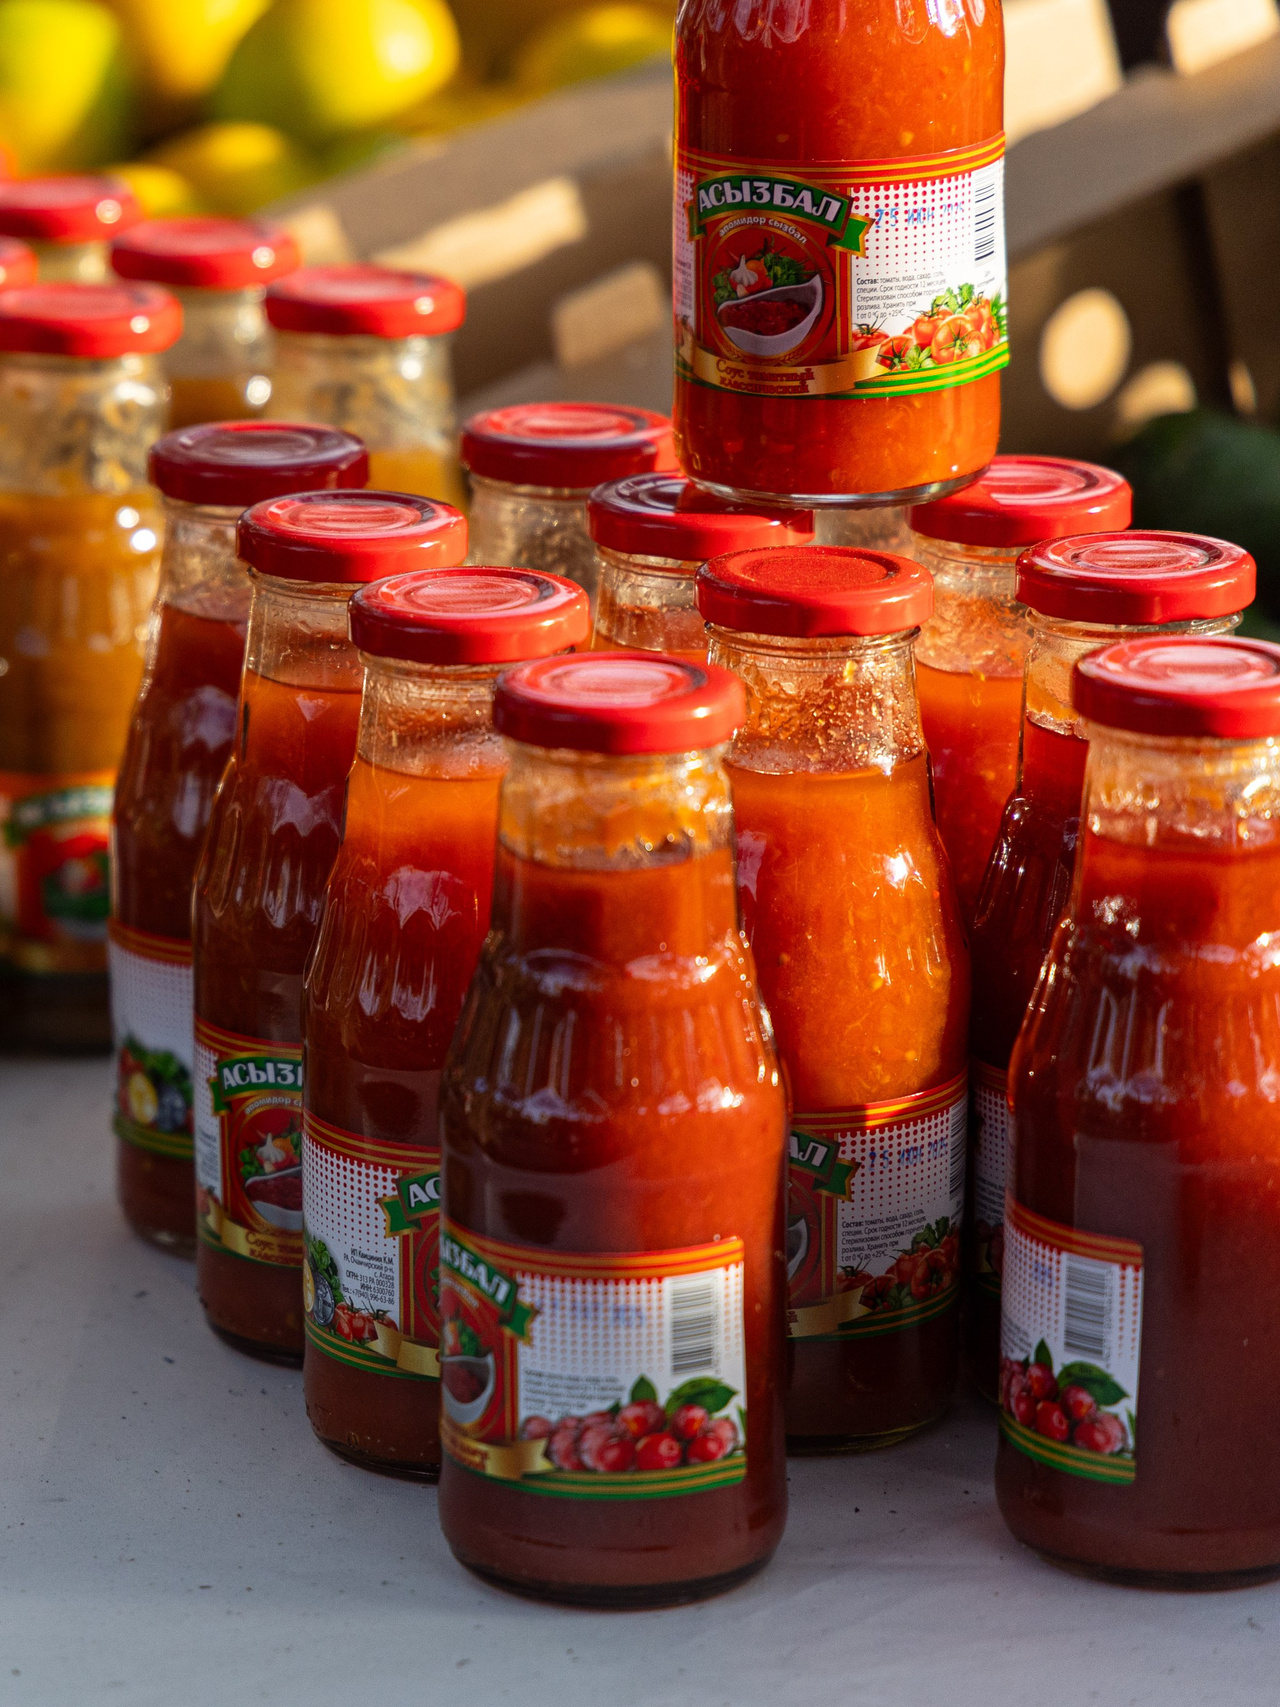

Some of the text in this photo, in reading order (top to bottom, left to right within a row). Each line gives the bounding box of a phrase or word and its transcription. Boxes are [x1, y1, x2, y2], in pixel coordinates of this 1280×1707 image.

[698, 181, 841, 222] АСЫЗБАЛ
[768, 218, 807, 244] сызбал
[856, 278, 879, 286] Состав:
[880, 285, 893, 293] Срок
[894, 283, 919, 292] годности
[856, 295, 896, 303] Стерилизован
[897, 290, 922, 299] способом
[883, 301, 905, 309] Хранить
[716, 360, 745, 379] Соус
[864, 1227, 878, 1235] Срок
[878, 1223, 901, 1232] годности
[842, 1238, 880, 1246] Стерилизован
[880, 1230, 904, 1239] способом
[351, 1248, 358, 1256] ИП
[867, 1243, 888, 1252] Хранить
[889, 1240, 899, 1249] при
[376, 1279, 394, 1289] 000328
[373, 1286, 394, 1298] 6300760
